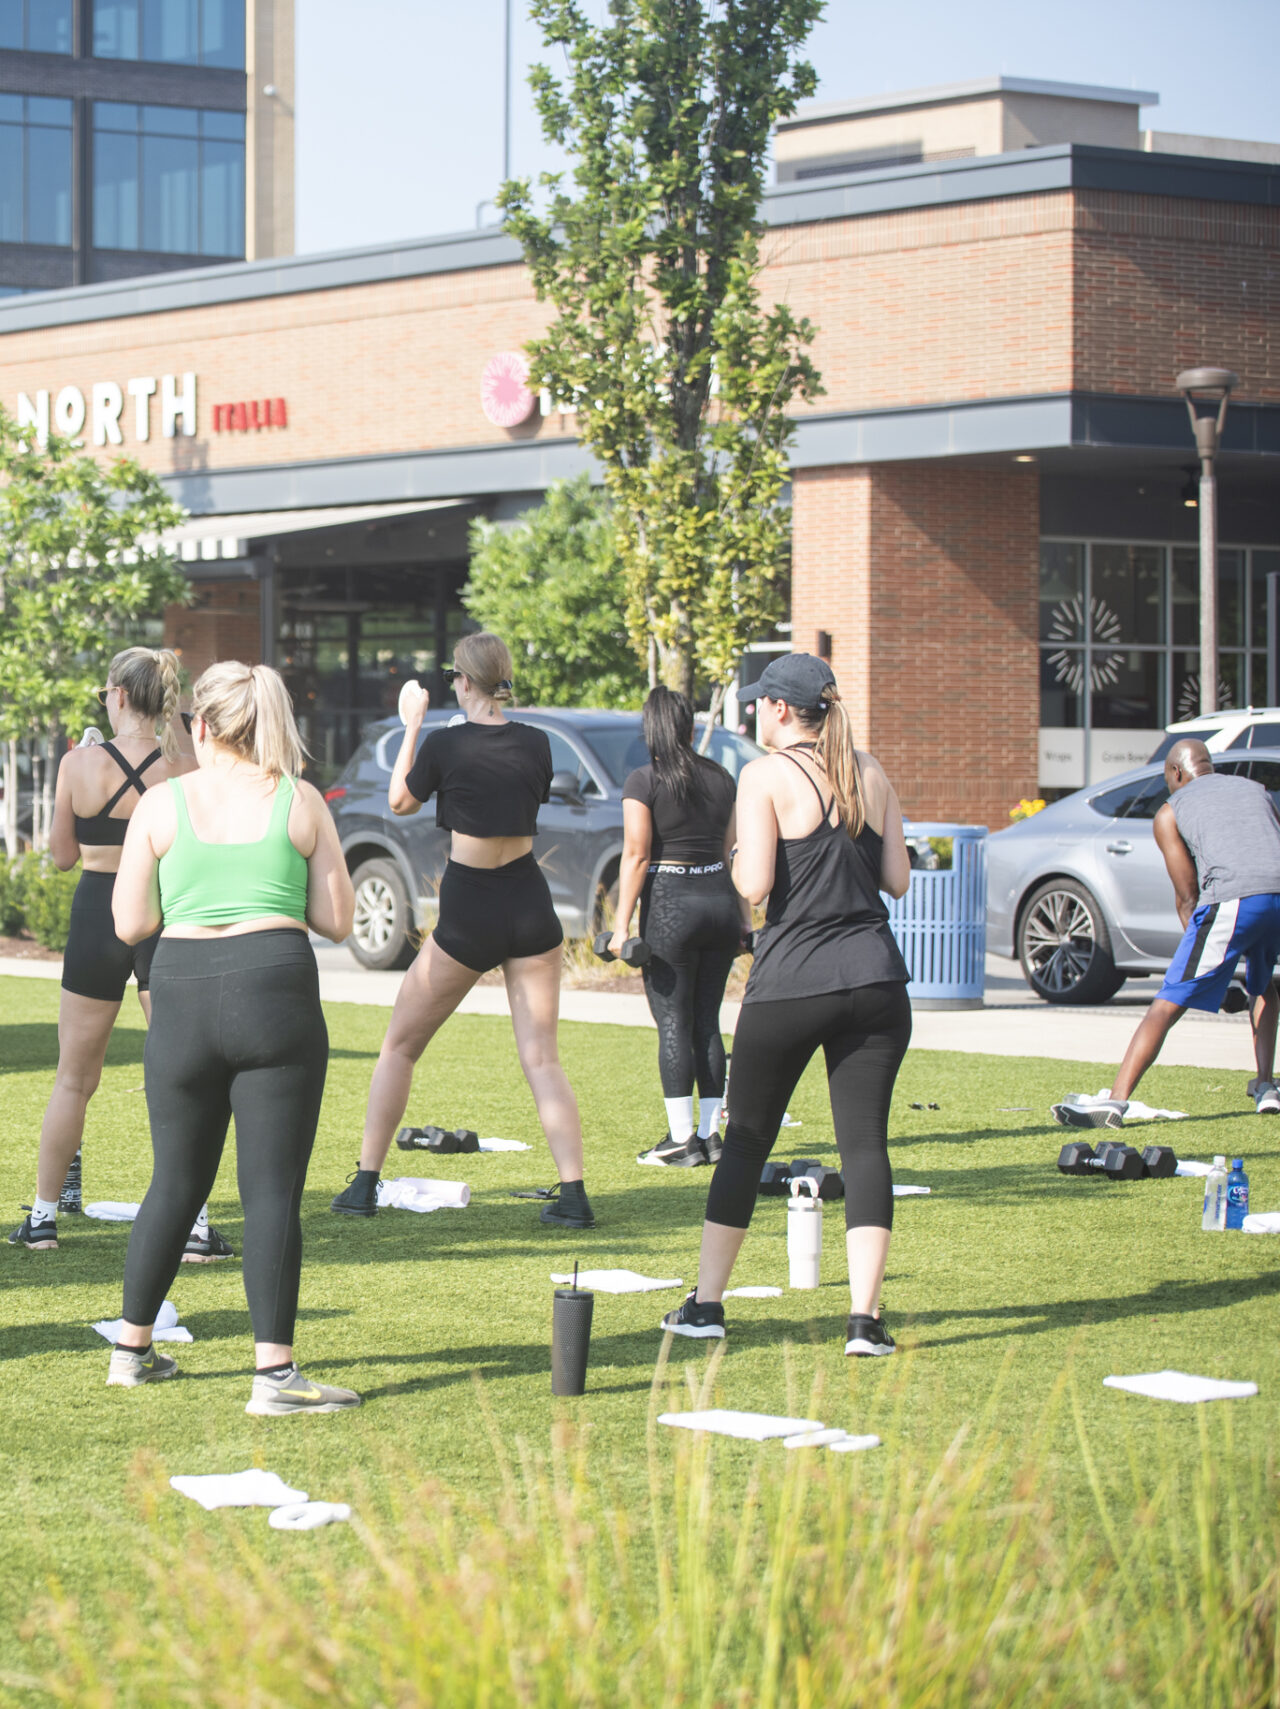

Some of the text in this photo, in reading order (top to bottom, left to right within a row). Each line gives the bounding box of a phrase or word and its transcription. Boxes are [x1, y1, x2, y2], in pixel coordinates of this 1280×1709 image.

[17, 372, 198, 453] NORTH
[657, 865, 686, 875] PRO
[703, 861, 725, 874] PRO
